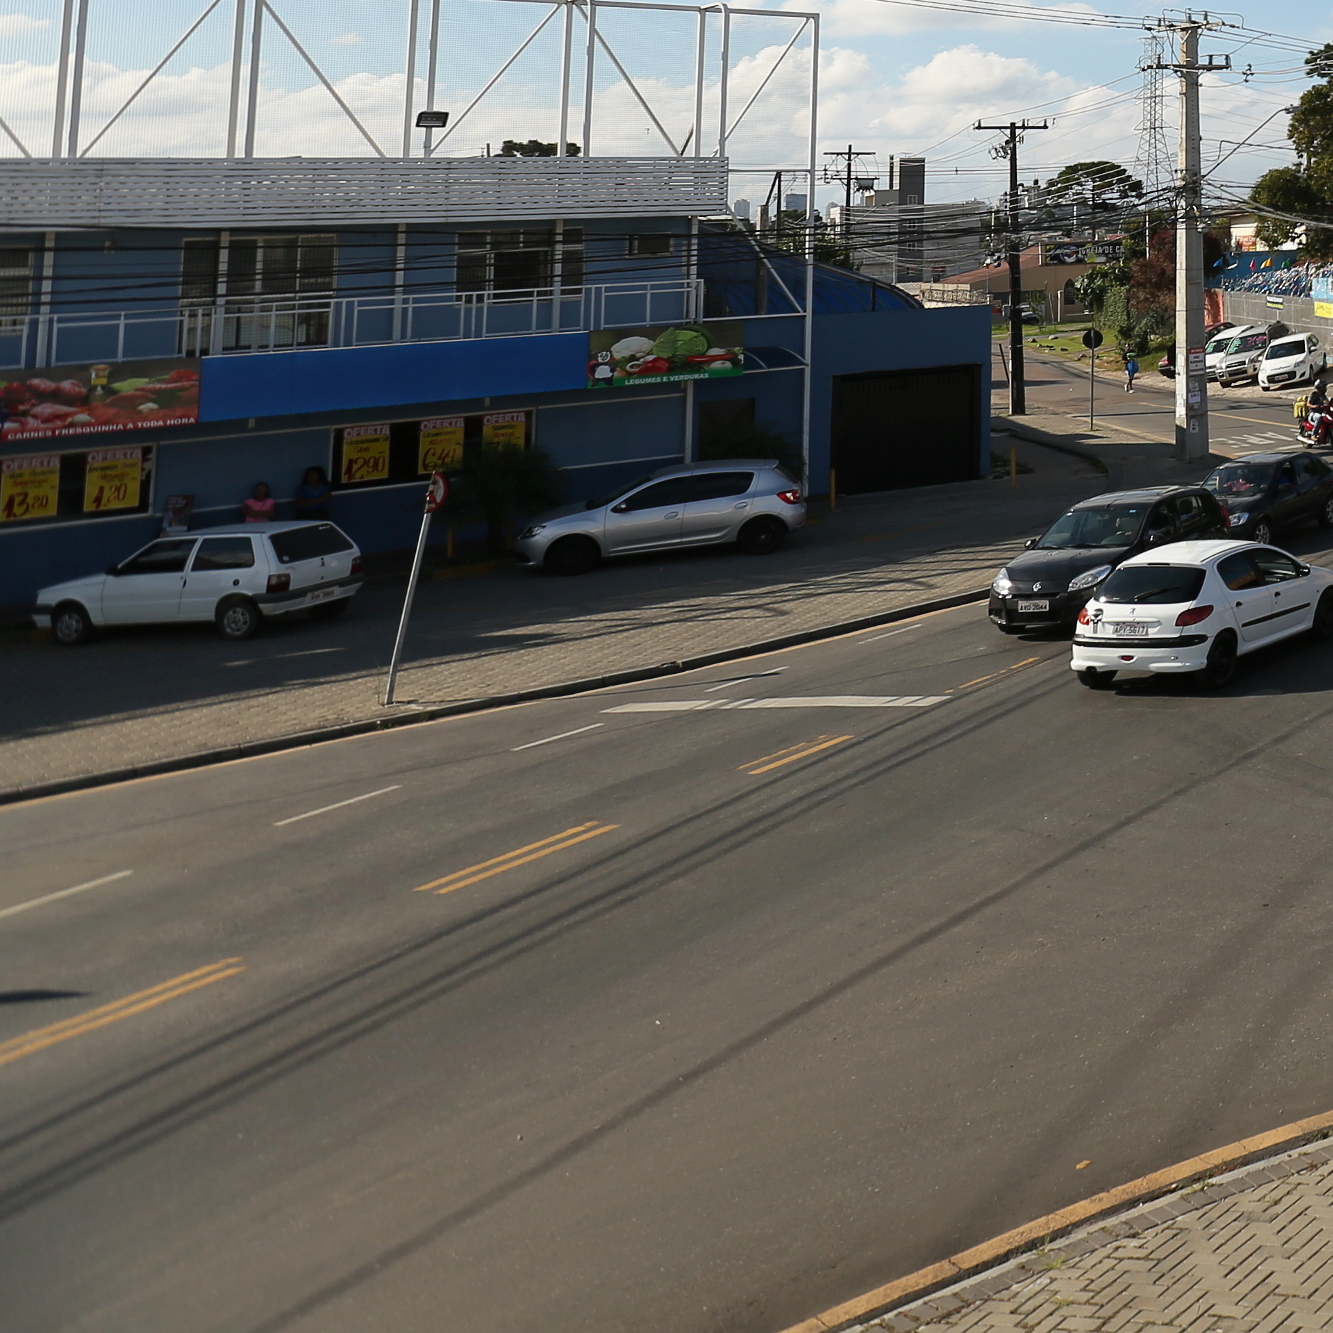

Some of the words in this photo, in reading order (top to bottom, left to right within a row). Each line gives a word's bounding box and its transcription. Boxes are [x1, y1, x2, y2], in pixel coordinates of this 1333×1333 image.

[625, 376, 661, 385] LEGUMES
[670, 372, 710, 381] VERDURAS
[420, 417, 465, 432] OFERTA
[483, 412, 526, 427] OFERTA
[7, 429, 53, 441] CARNES
[55, 423, 124, 436] FRESQUINHA
[137, 419, 164, 429] TODA
[166, 417, 196, 426] HORA
[343, 424, 390, 439] OFERTA
[87, 446, 142, 463] OFERTA
[2, 456, 60, 472] OFERTA
